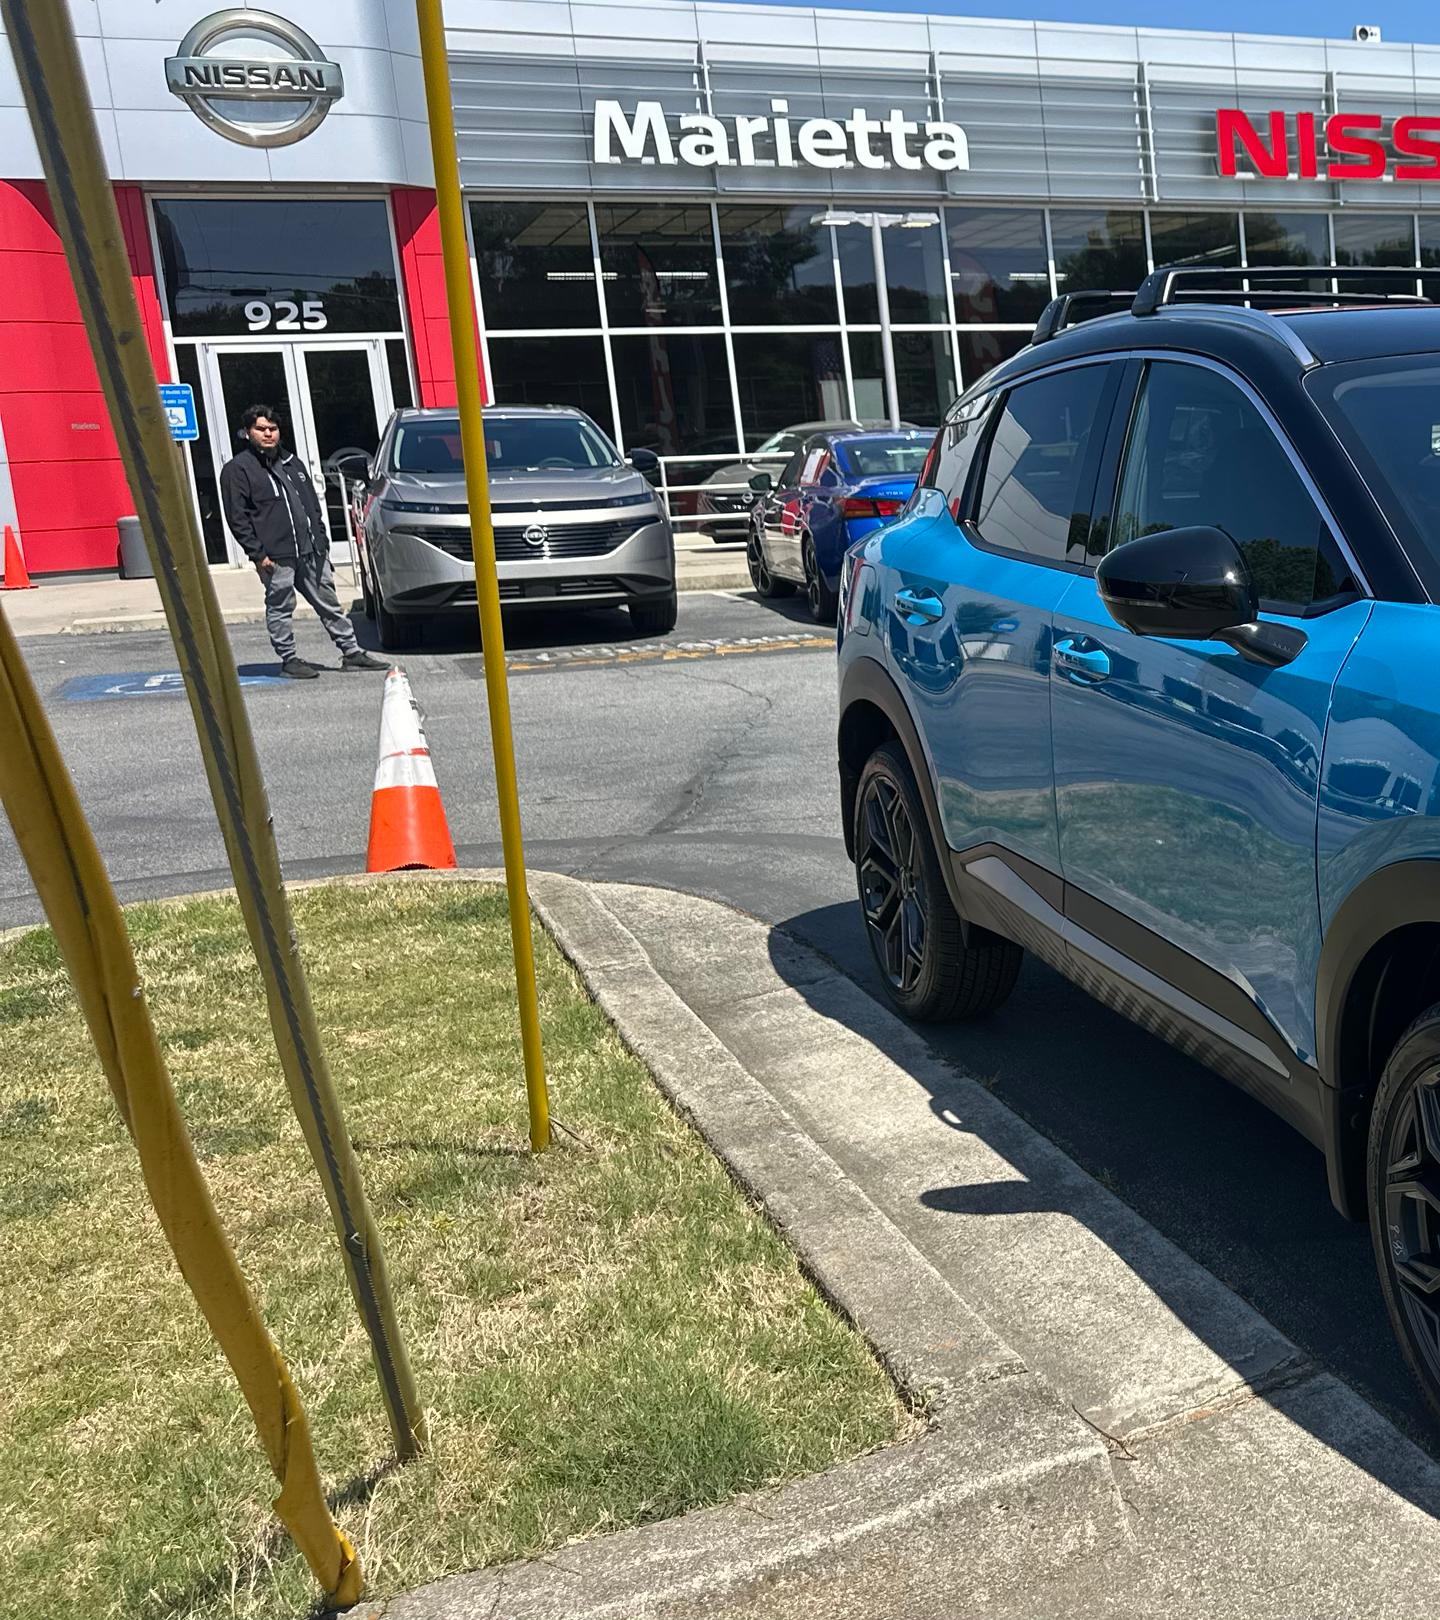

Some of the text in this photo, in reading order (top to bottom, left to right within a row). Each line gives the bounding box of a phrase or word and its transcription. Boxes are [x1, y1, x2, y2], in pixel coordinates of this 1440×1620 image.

[185, 65, 326, 90] NISSAN
[593, 99, 970, 170] Marietta
[244, 301, 328, 331] 925
